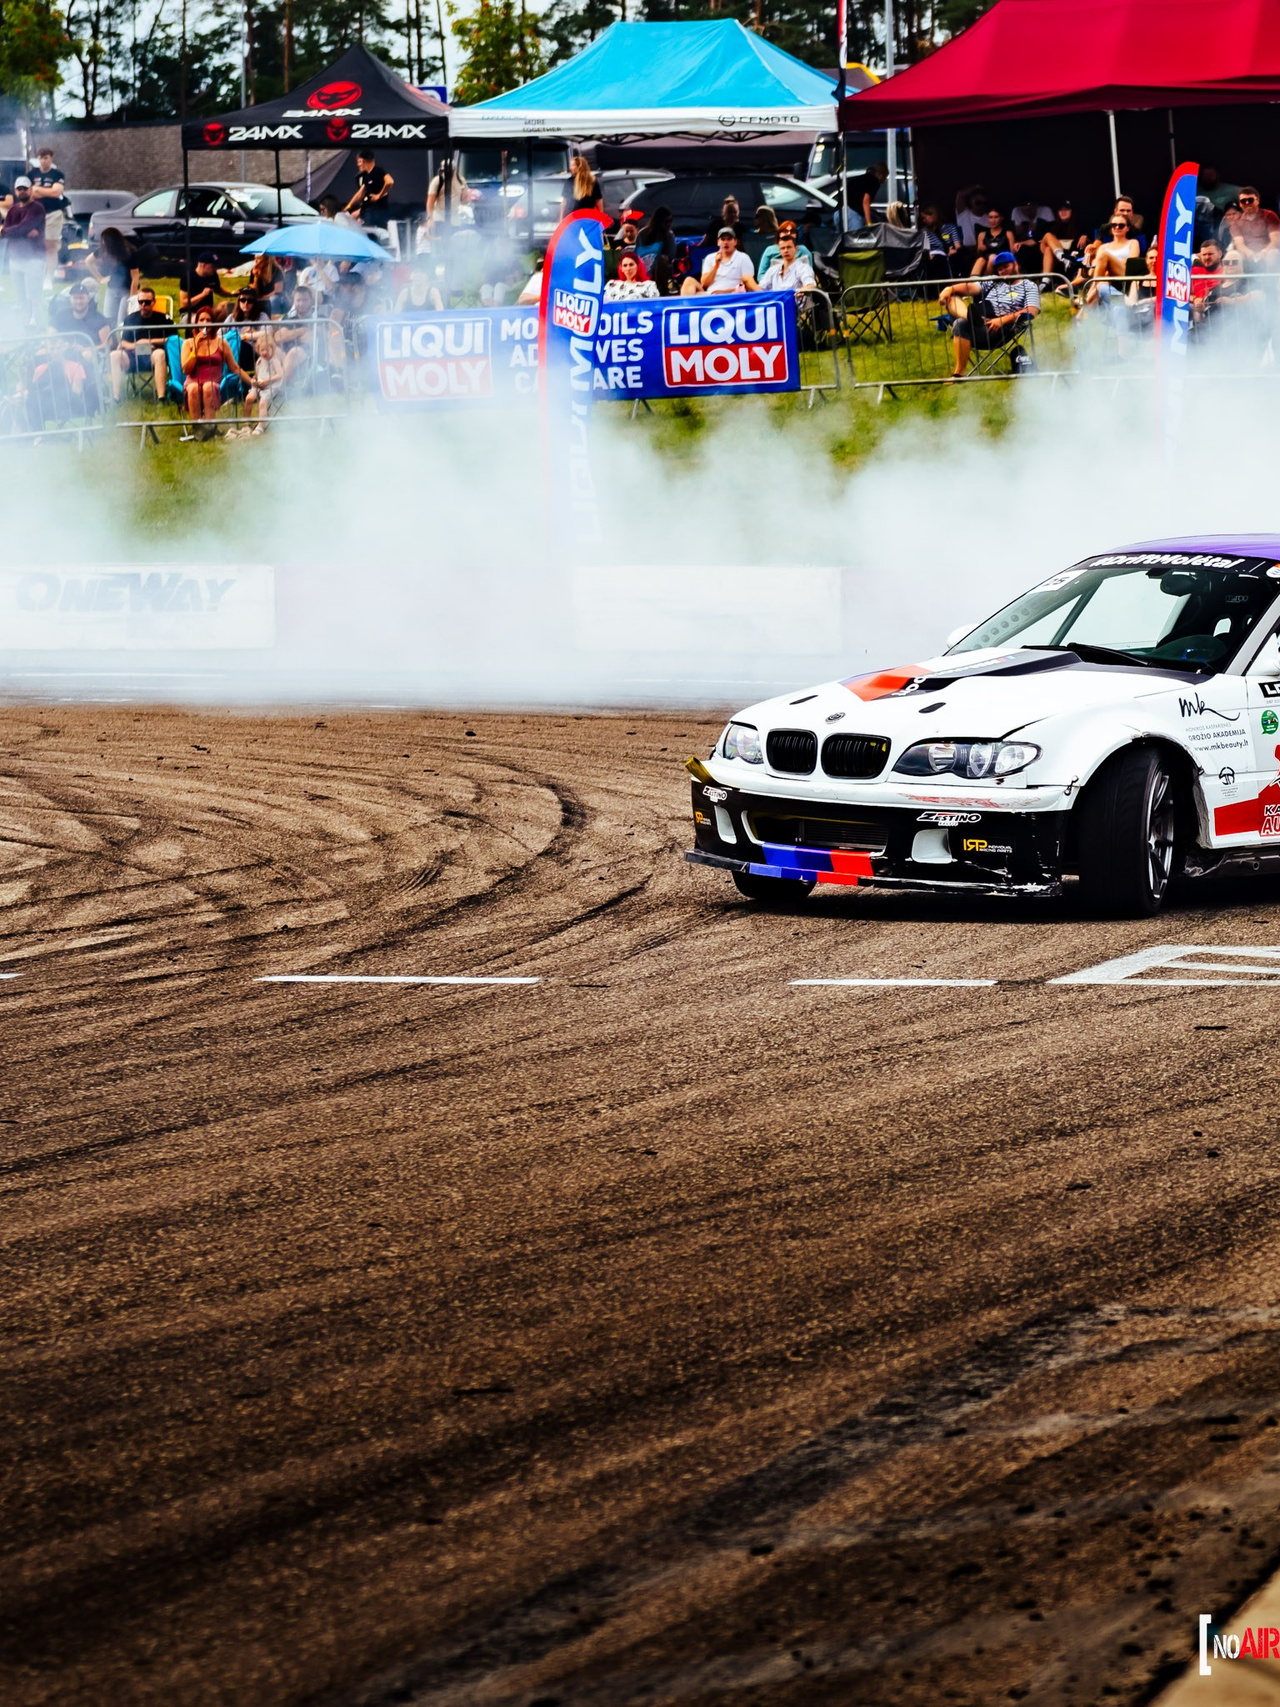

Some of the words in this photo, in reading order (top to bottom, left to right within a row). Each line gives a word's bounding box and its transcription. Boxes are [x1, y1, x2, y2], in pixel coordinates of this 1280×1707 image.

[229, 124, 303, 142] 24MX
[351, 124, 427, 139] 24MX
[556, 290, 591, 316] LIQUI
[555, 307, 591, 332] MOLY
[669, 306, 778, 345] LIQUI
[382, 321, 485, 359] LIQUI
[670, 345, 783, 383] MOLY
[384, 360, 488, 397] MOLY
[592, 366, 644, 391] ARE
[1188, 731, 1212, 742] GROŽIO
[1213, 728, 1246, 738] AKADEMIJA
[1194, 739, 1249, 752] www.mkbeauty.lt
[916, 808, 982, 823] ZESTINO
